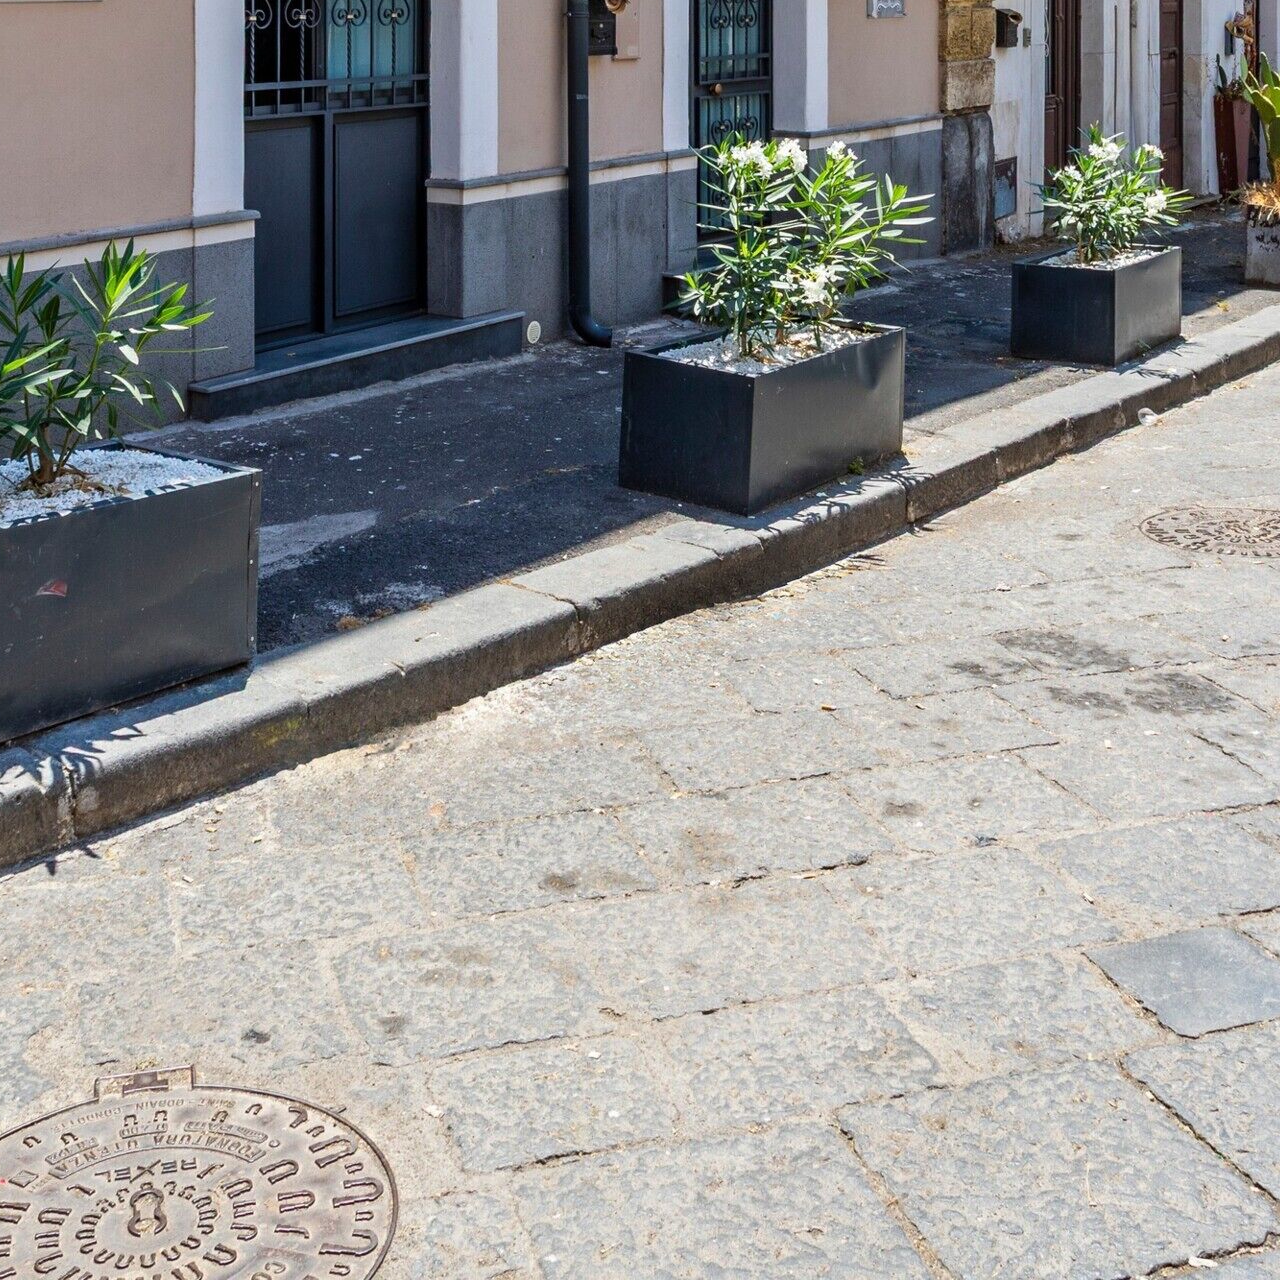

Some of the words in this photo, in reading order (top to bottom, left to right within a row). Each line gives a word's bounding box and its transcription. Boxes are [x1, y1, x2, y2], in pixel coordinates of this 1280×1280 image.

[54, 1140, 139, 1172] UTENZA
[153, 1134, 261, 1158] FOGNATURA
[95, 1158, 198, 1183] REXEL
